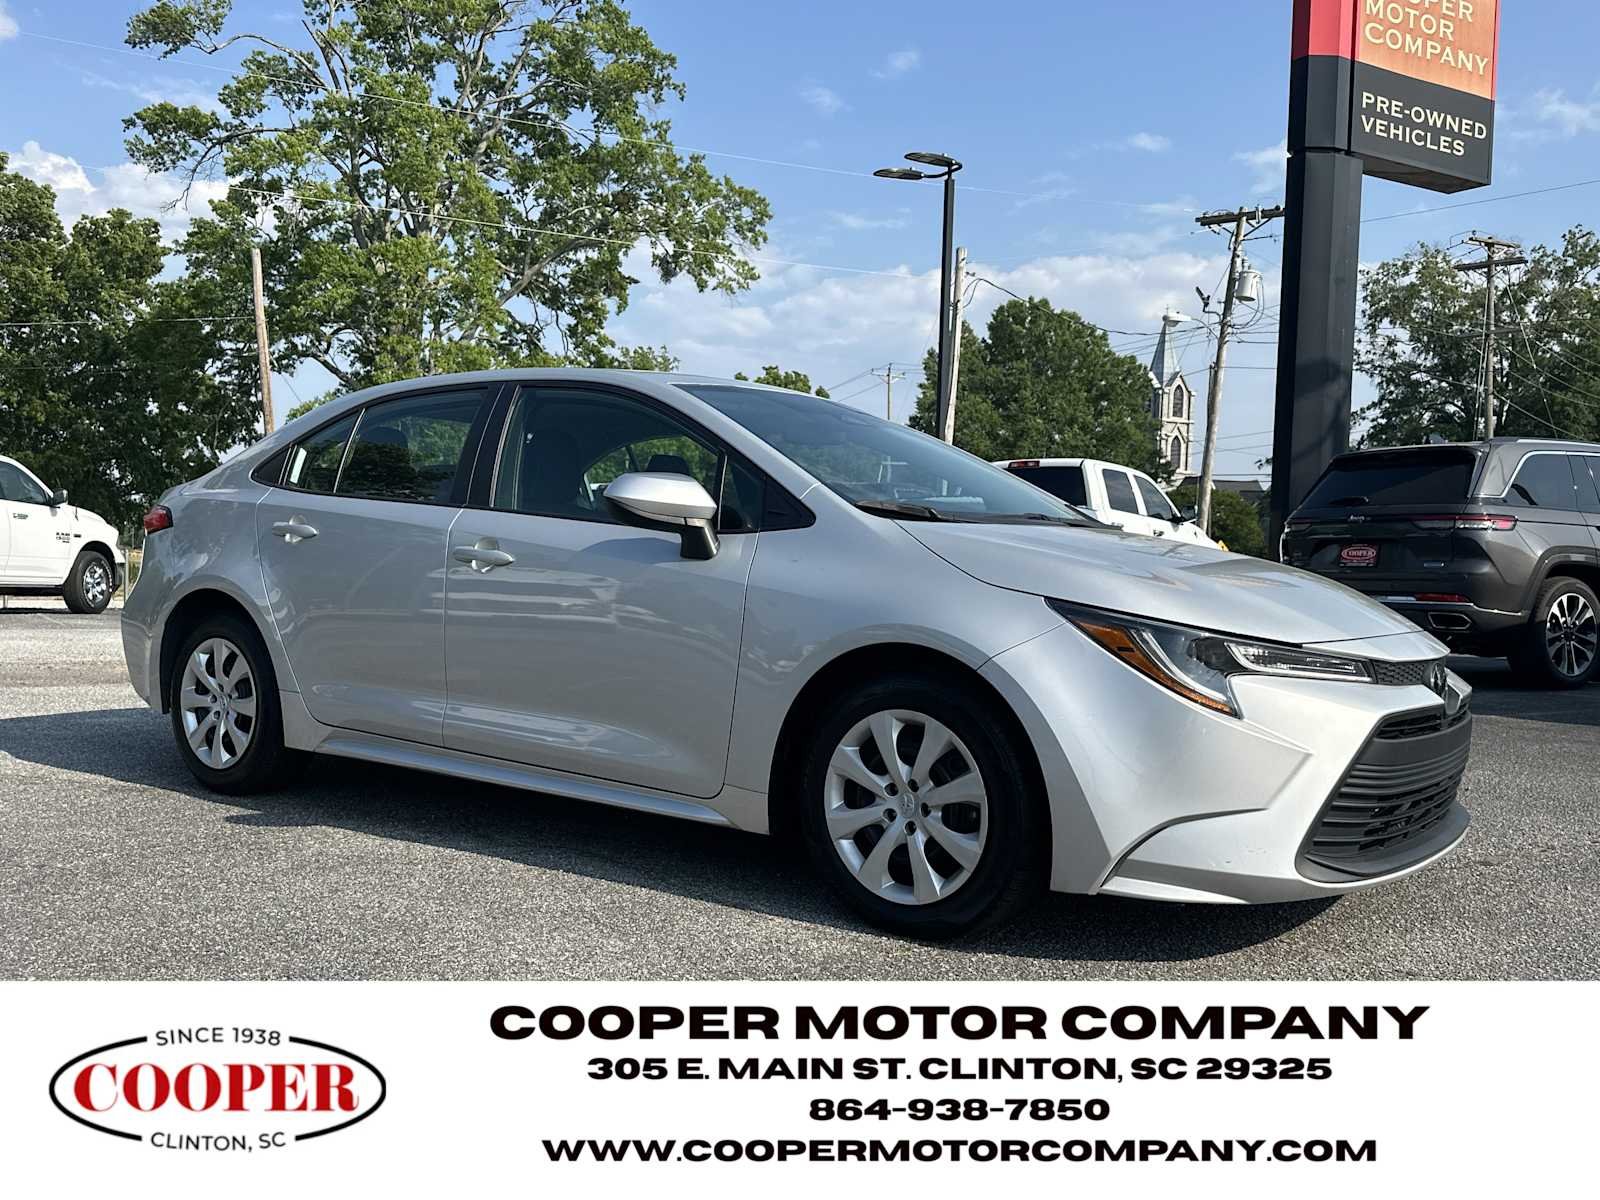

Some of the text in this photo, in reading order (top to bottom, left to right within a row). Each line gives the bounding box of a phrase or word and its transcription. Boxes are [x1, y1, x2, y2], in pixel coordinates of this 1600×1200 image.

[1365, 0, 1454, 41] MOTOR
[1364, 22, 1489, 75] COMPANY
[1361, 91, 1487, 140] PRE-OWNED
[1361, 115, 1465, 156] VEHICLES
